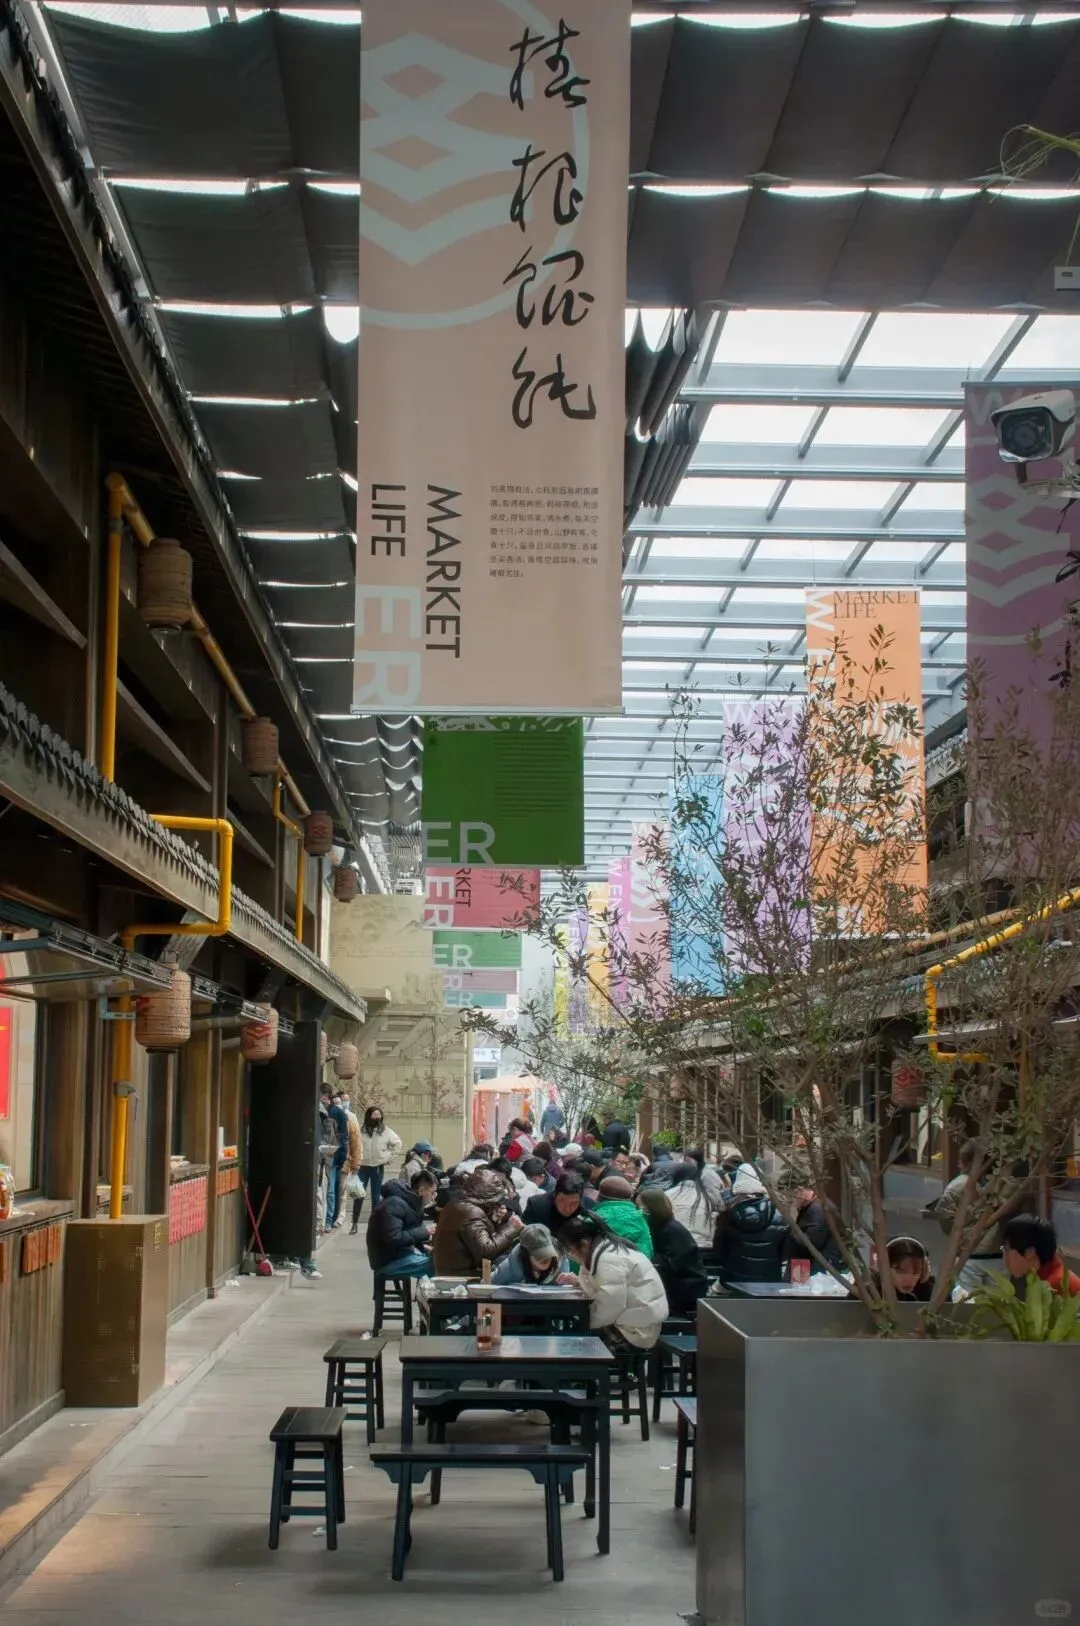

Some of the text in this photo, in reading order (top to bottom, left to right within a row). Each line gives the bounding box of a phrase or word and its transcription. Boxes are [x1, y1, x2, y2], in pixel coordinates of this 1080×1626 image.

[371, 484, 406, 557] LIFE
[425, 484, 463, 658] MARKET
[833, 603, 877, 619] LIFE
[422, 821, 496, 864] ER
[424, 876, 455, 928] ER
[432, 944, 473, 969] ER
